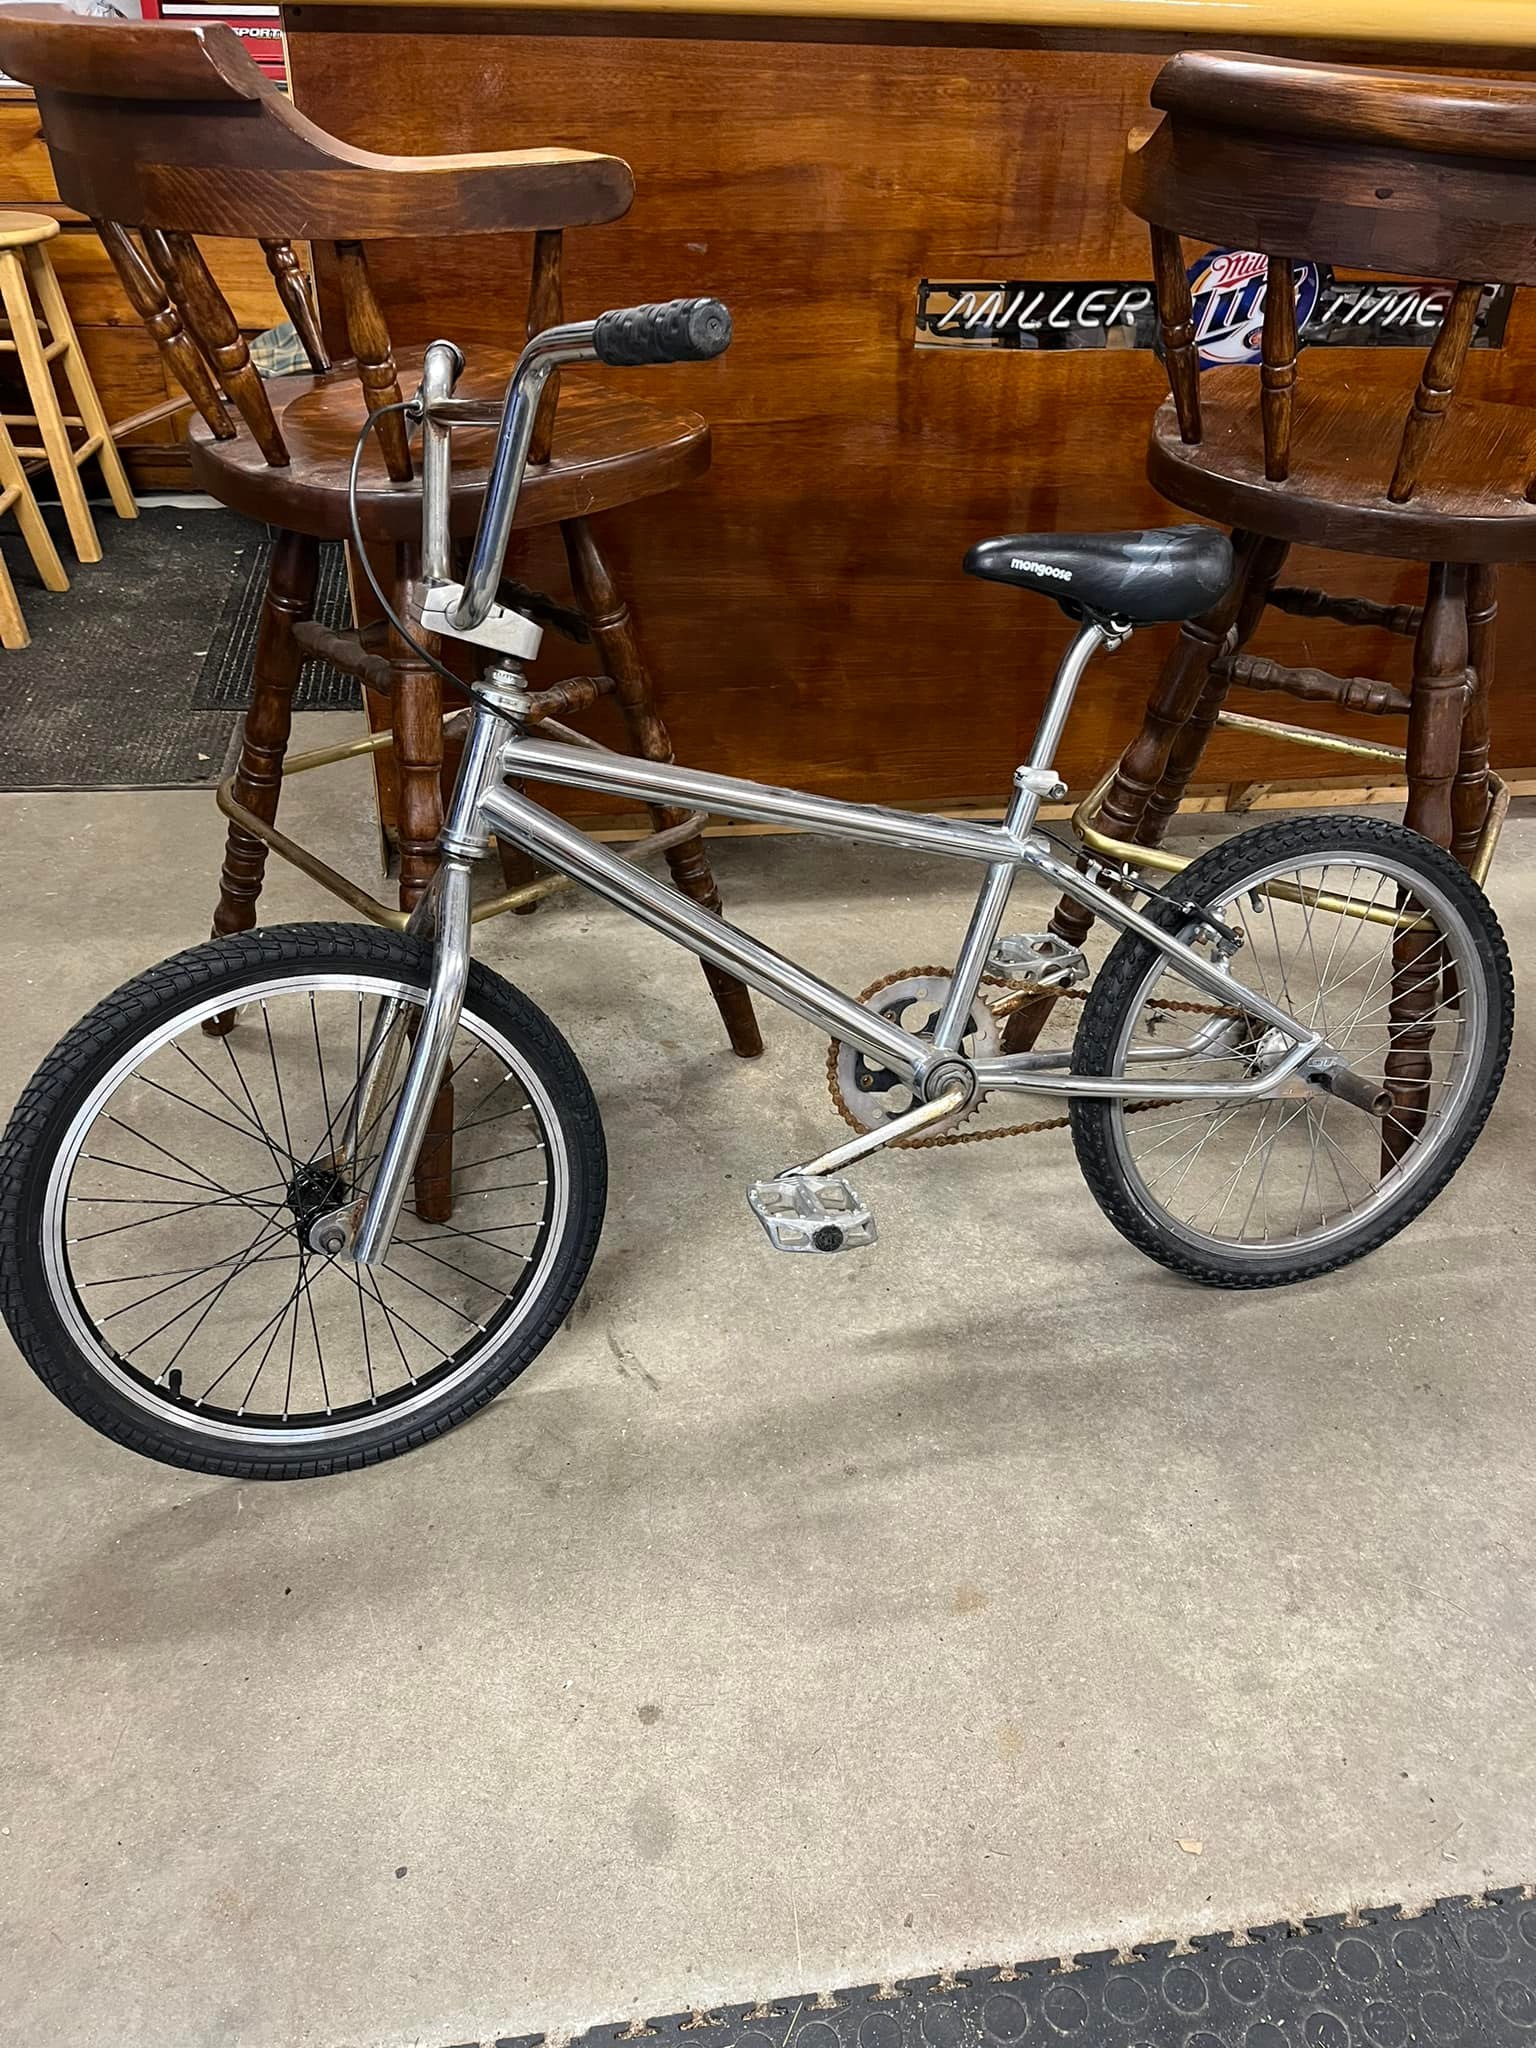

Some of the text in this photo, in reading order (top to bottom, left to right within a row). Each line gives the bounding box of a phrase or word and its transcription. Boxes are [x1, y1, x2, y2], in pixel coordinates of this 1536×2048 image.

[1212, 251, 1268, 287] Mill
[936, 286, 1453, 329] MILLER TIME
[1010, 558, 1073, 581] mongoose
